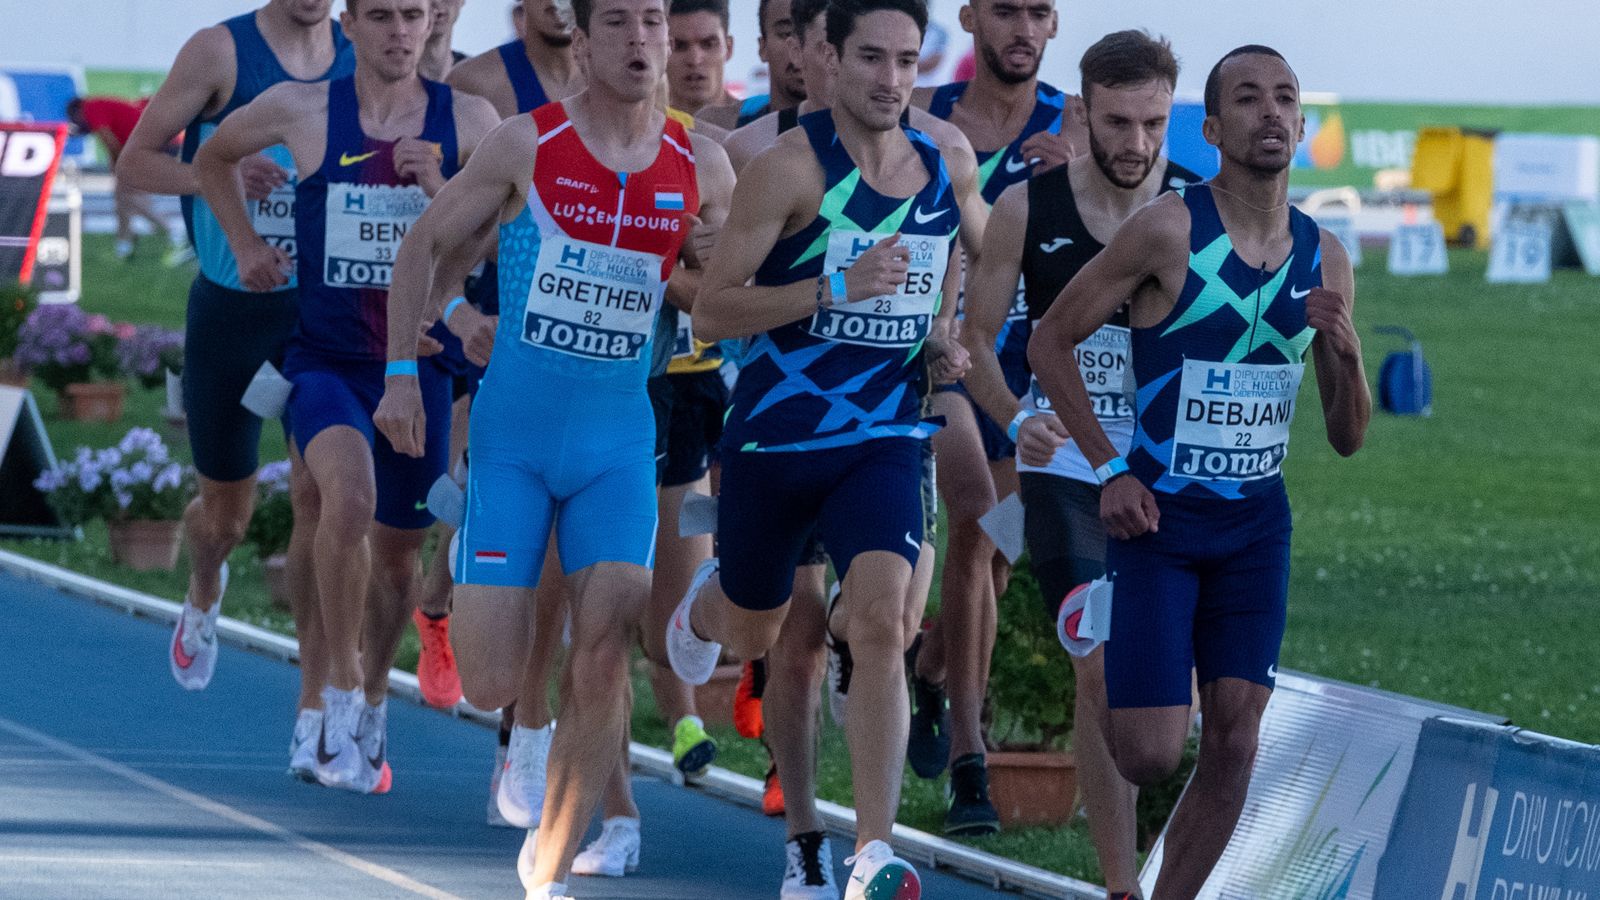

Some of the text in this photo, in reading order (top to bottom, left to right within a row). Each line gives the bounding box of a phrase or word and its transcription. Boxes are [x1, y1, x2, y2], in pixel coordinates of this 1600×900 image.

[375, 247, 392, 260] 33
[909, 251, 933, 261] ELVA
[607, 263, 648, 278] HUELVA
[538, 272, 653, 313] GRETHEN
[874, 299, 892, 314] 23
[583, 310, 602, 326] 82
[1085, 371, 1107, 386] 95
[1233, 380, 1290, 391] DE HUELVA
[1185, 398, 1292, 427] DEBJANI
[1234, 432, 1252, 447] 22
